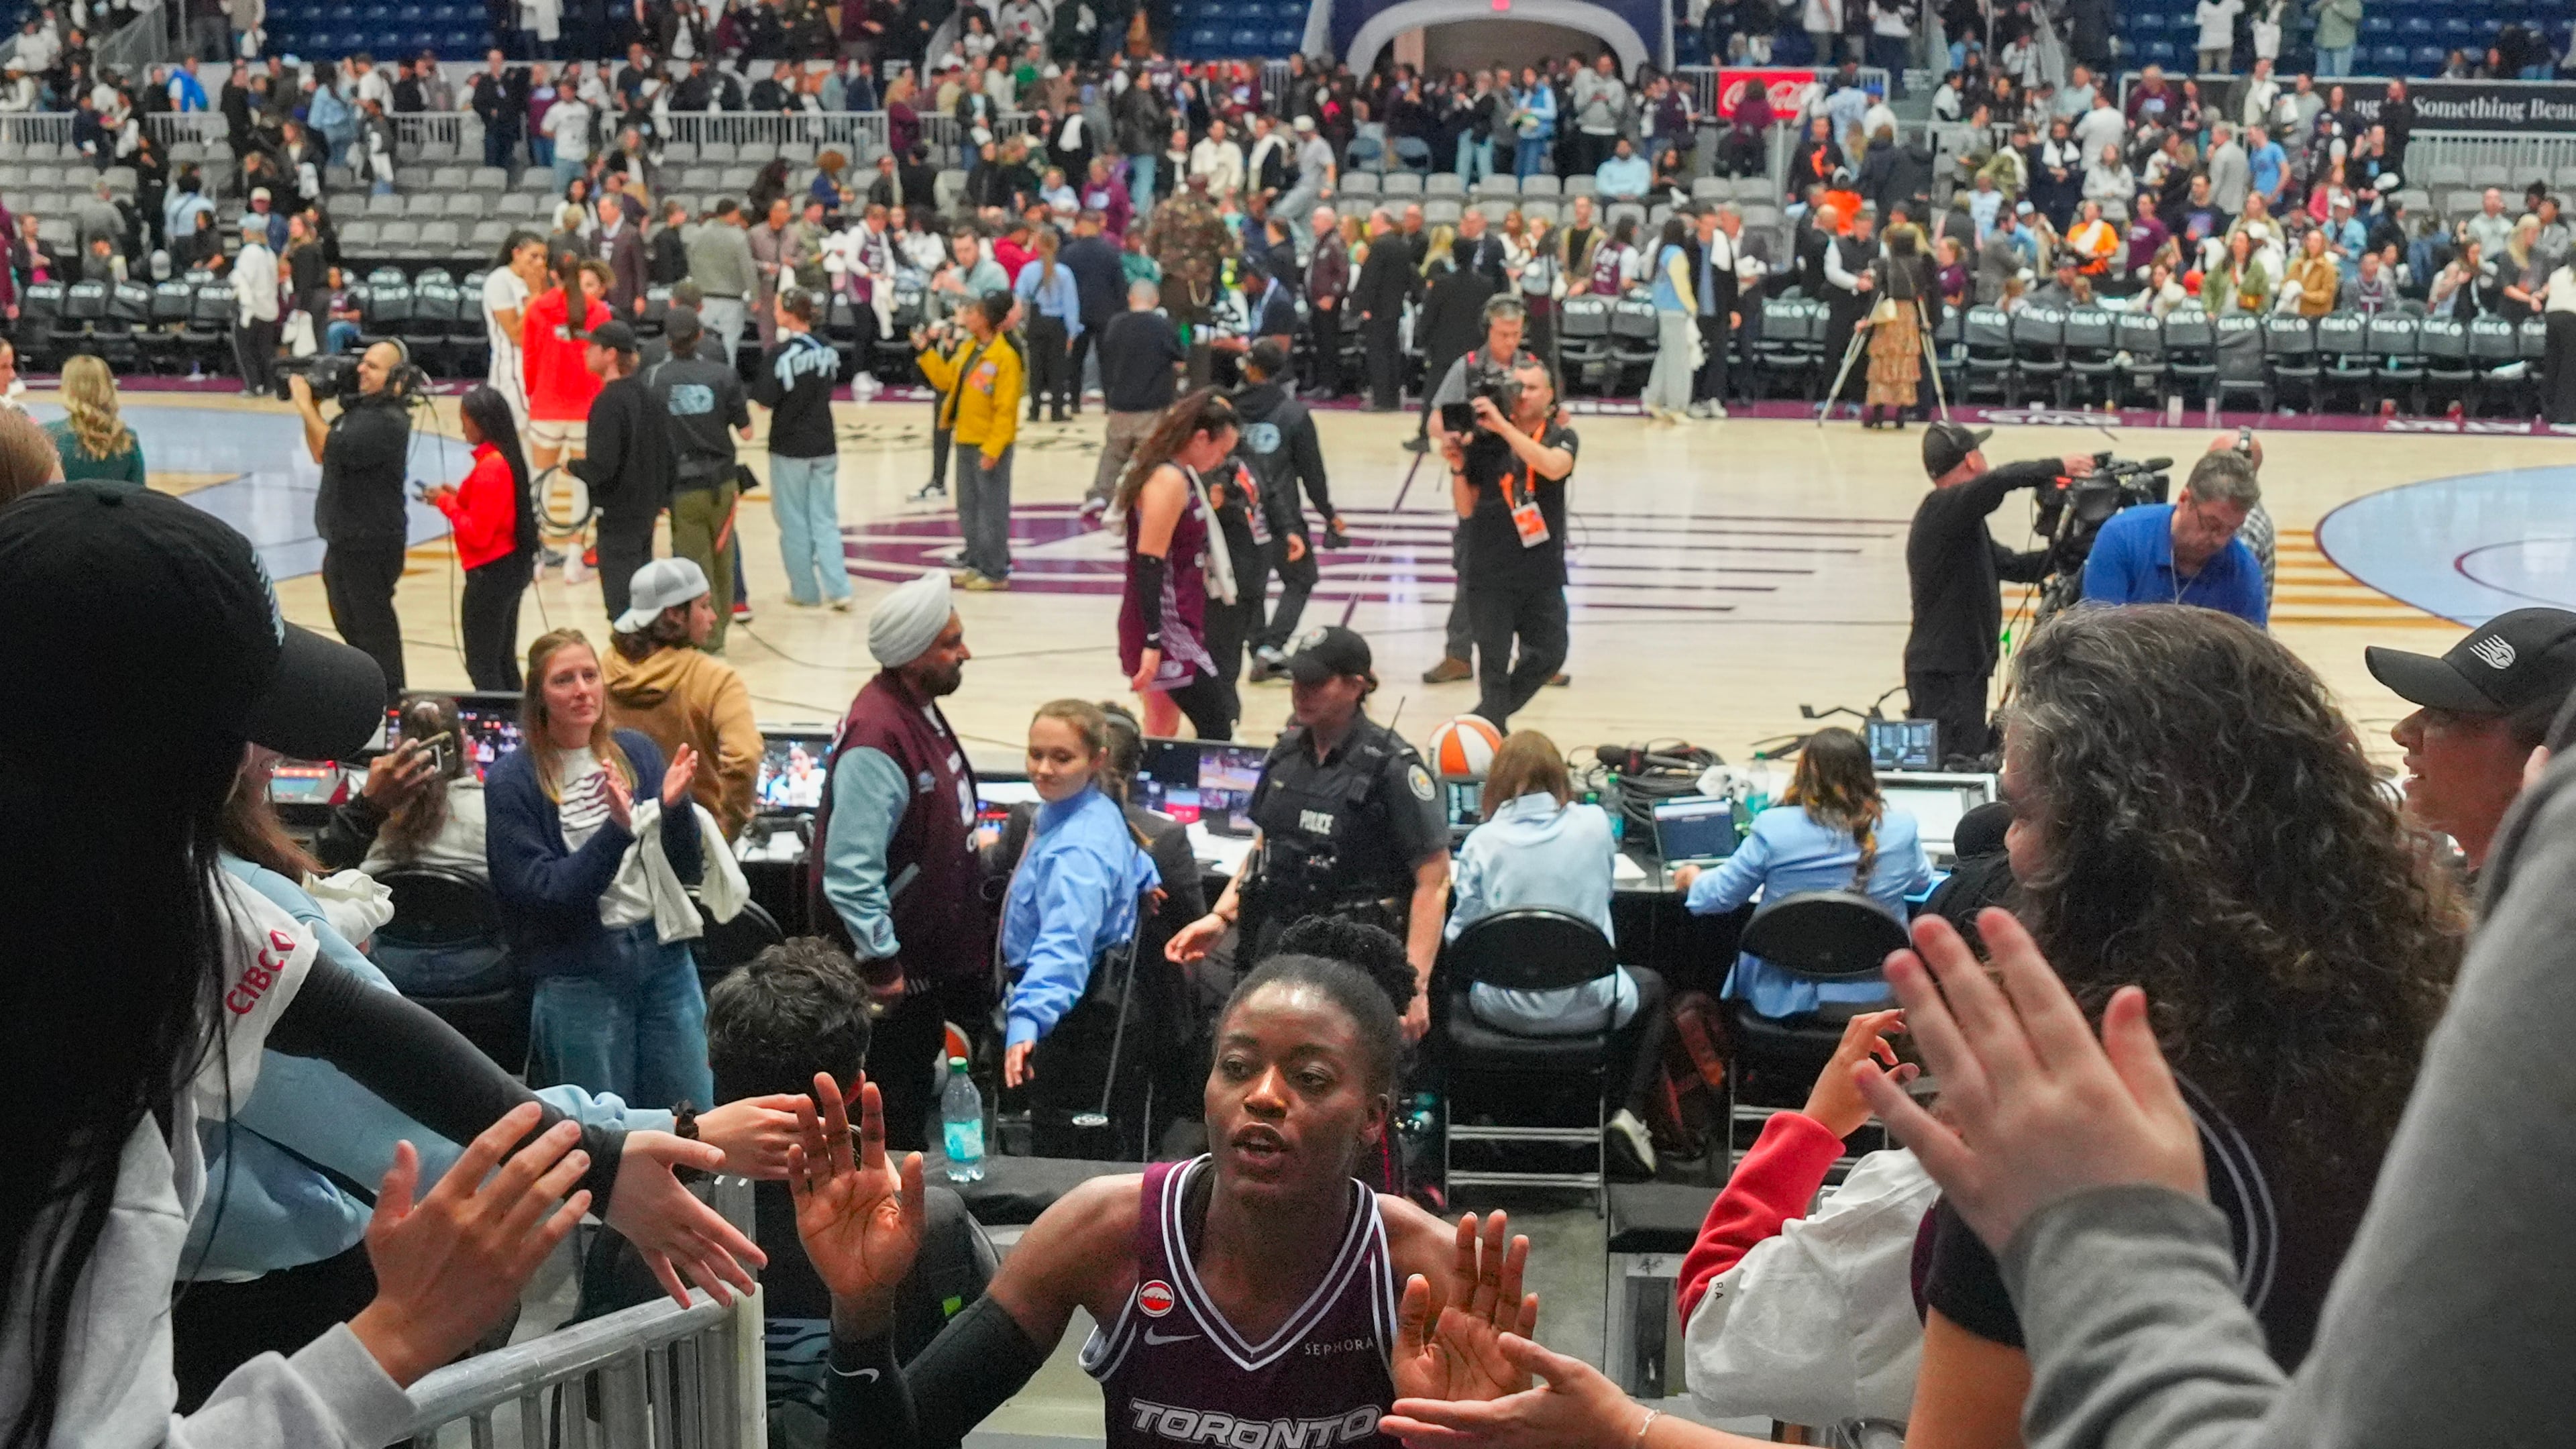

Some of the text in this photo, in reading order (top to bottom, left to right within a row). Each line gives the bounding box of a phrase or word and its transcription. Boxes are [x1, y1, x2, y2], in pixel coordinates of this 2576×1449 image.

[2412, 96, 2525, 123] Something
[1299, 809, 1334, 835] POLICE
[226, 947, 284, 1014] CIBC
[1305, 1336, 1374, 1355] SEPHORA
[1130, 1397, 1383, 1449] TORONTO
